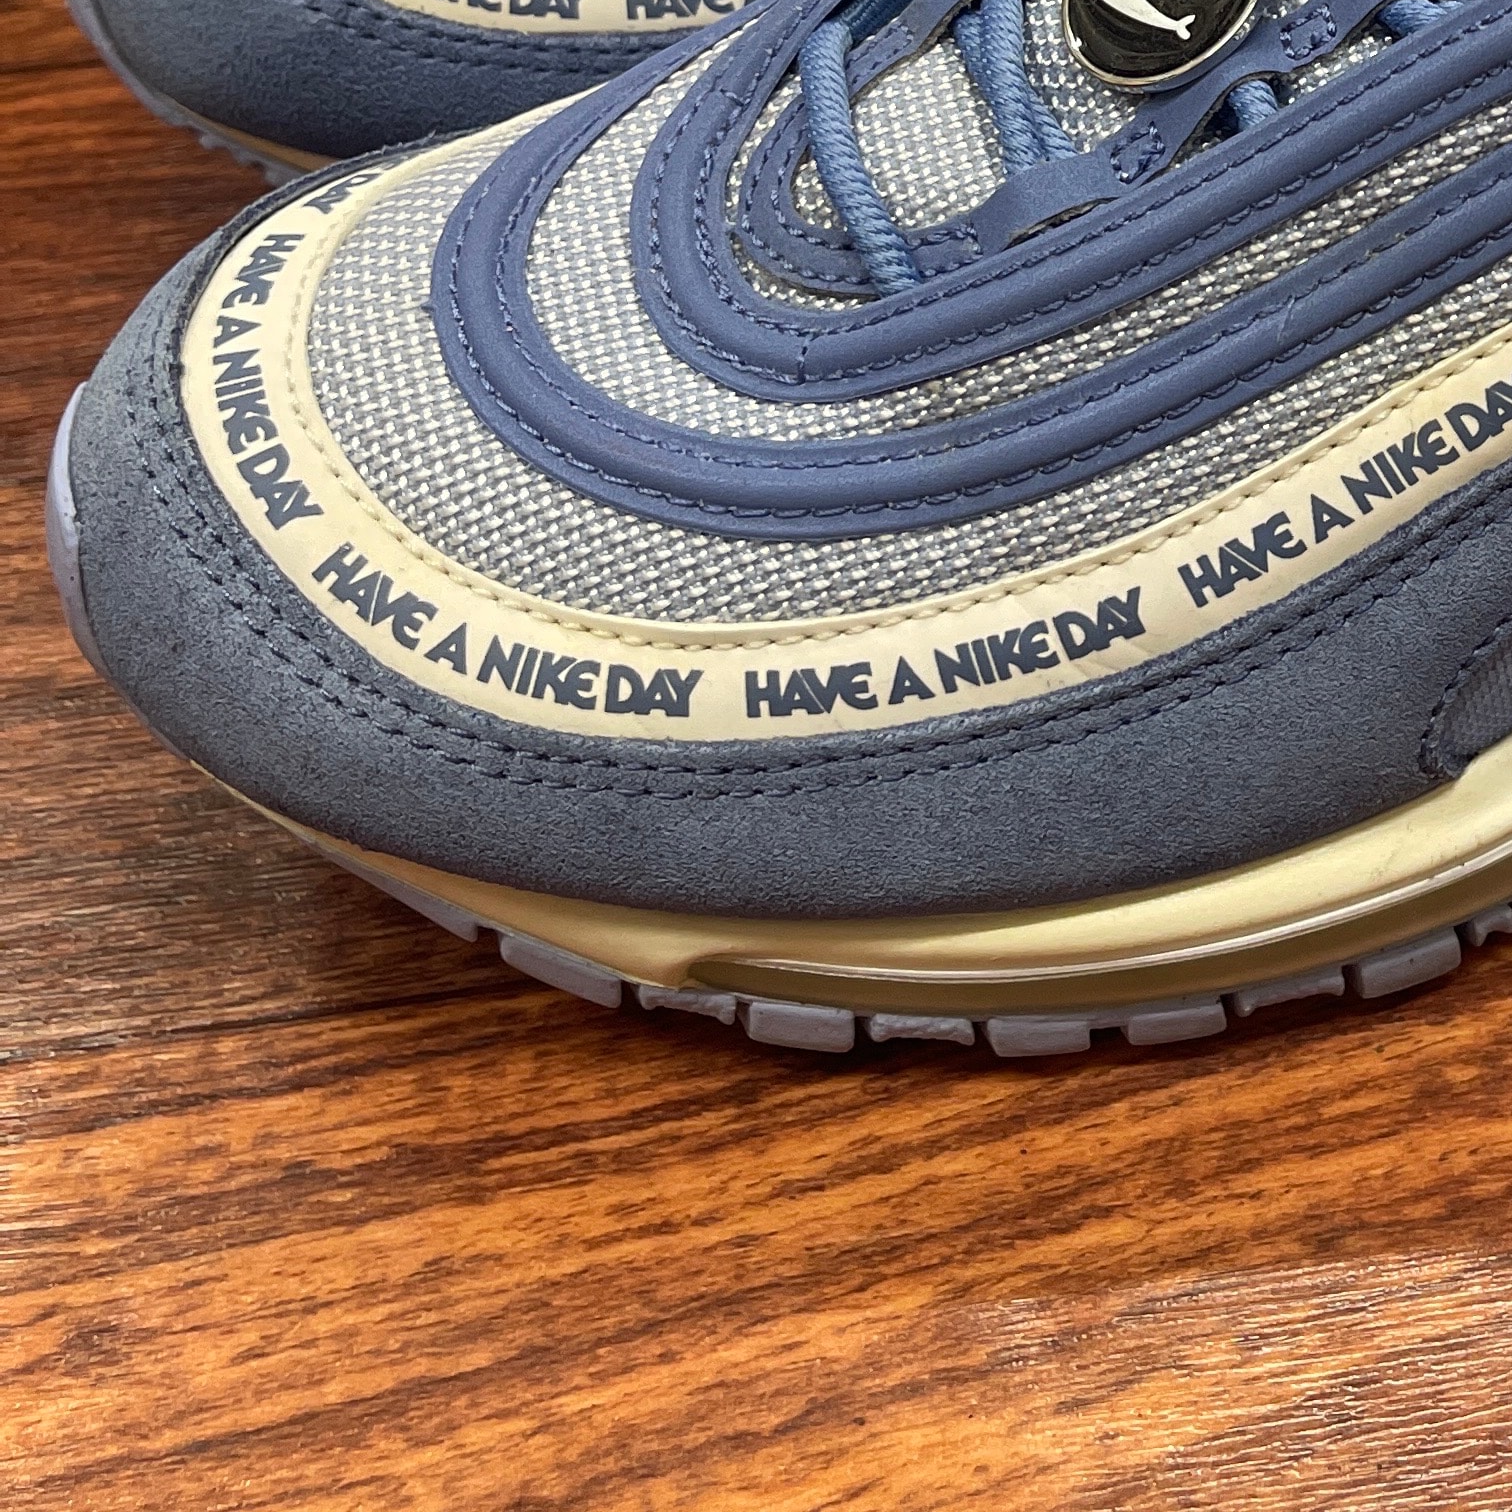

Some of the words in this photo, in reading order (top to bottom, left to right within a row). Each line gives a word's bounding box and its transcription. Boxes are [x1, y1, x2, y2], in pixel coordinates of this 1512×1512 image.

[221, 233, 305, 309] HAVE
[212, 315, 262, 349] A
[1177, 510, 1308, 609] HAVE
[1309, 493, 1356, 544] A
[311, 540, 439, 651] HAVE
[424, 622, 468, 676] A
[744, 661, 879, 718] HAVE
[887, 655, 935, 705] A
